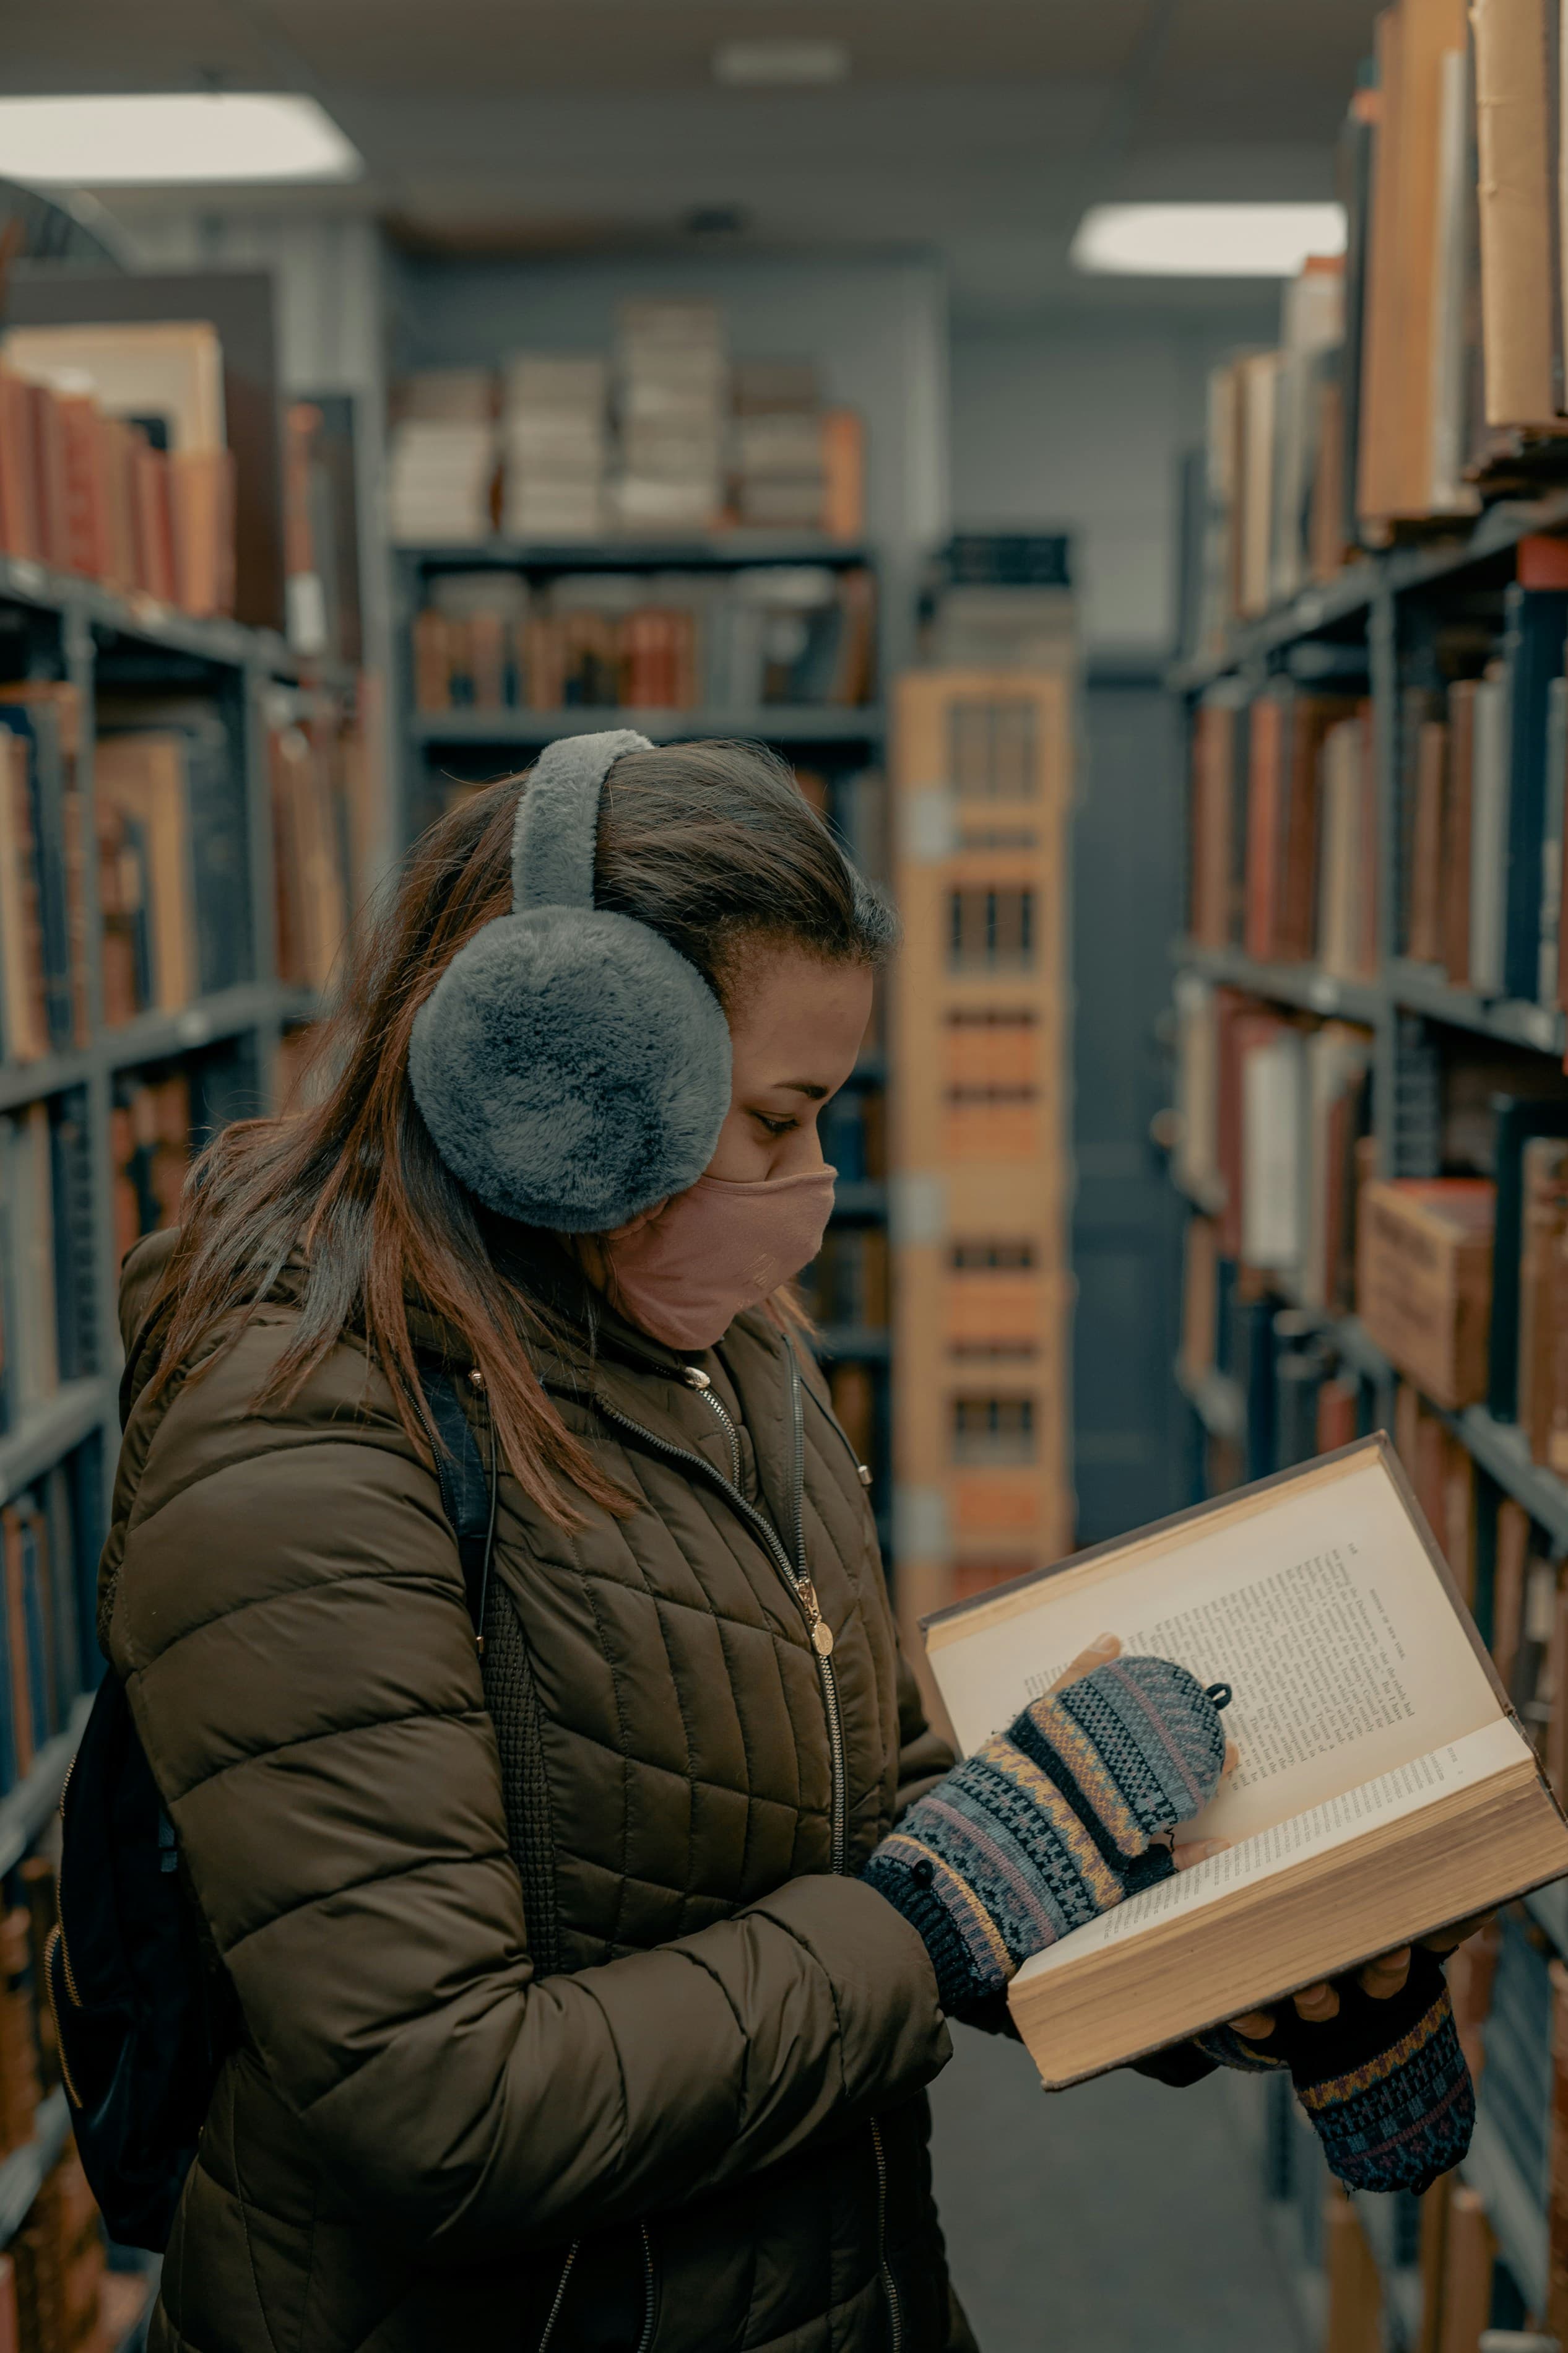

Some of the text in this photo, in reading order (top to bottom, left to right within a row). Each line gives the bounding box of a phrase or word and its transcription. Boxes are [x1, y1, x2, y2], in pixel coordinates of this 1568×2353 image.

[1336, 1683, 1351, 1703] which
[1346, 1703, 1356, 1716] the
[1403, 1702, 1415, 1716] had
[1356, 1705, 1375, 1734] entirely
[1380, 1703, 1395, 1725] noted
[1392, 1702, 1405, 1721] have
[1315, 1712, 1333, 1741] Trenton
[1336, 1708, 1351, 1729] which
[1346, 1730, 1356, 1741] he
[1375, 1717, 1385, 1729] for
[1283, 1721, 1308, 1763] transported
[1299, 1728, 1314, 1749] made
[1309, 1749, 1318, 1759] in
[1309, 1723, 1322, 1741] built
[1318, 1742, 1328, 1754] of
[1263, 1747, 1274, 1760] but
[1278, 1757, 1289, 1770] the
[1250, 1772, 1260, 1782] be
[1258, 1765, 1269, 1778] not
[1268, 1760, 1280, 1774] the
